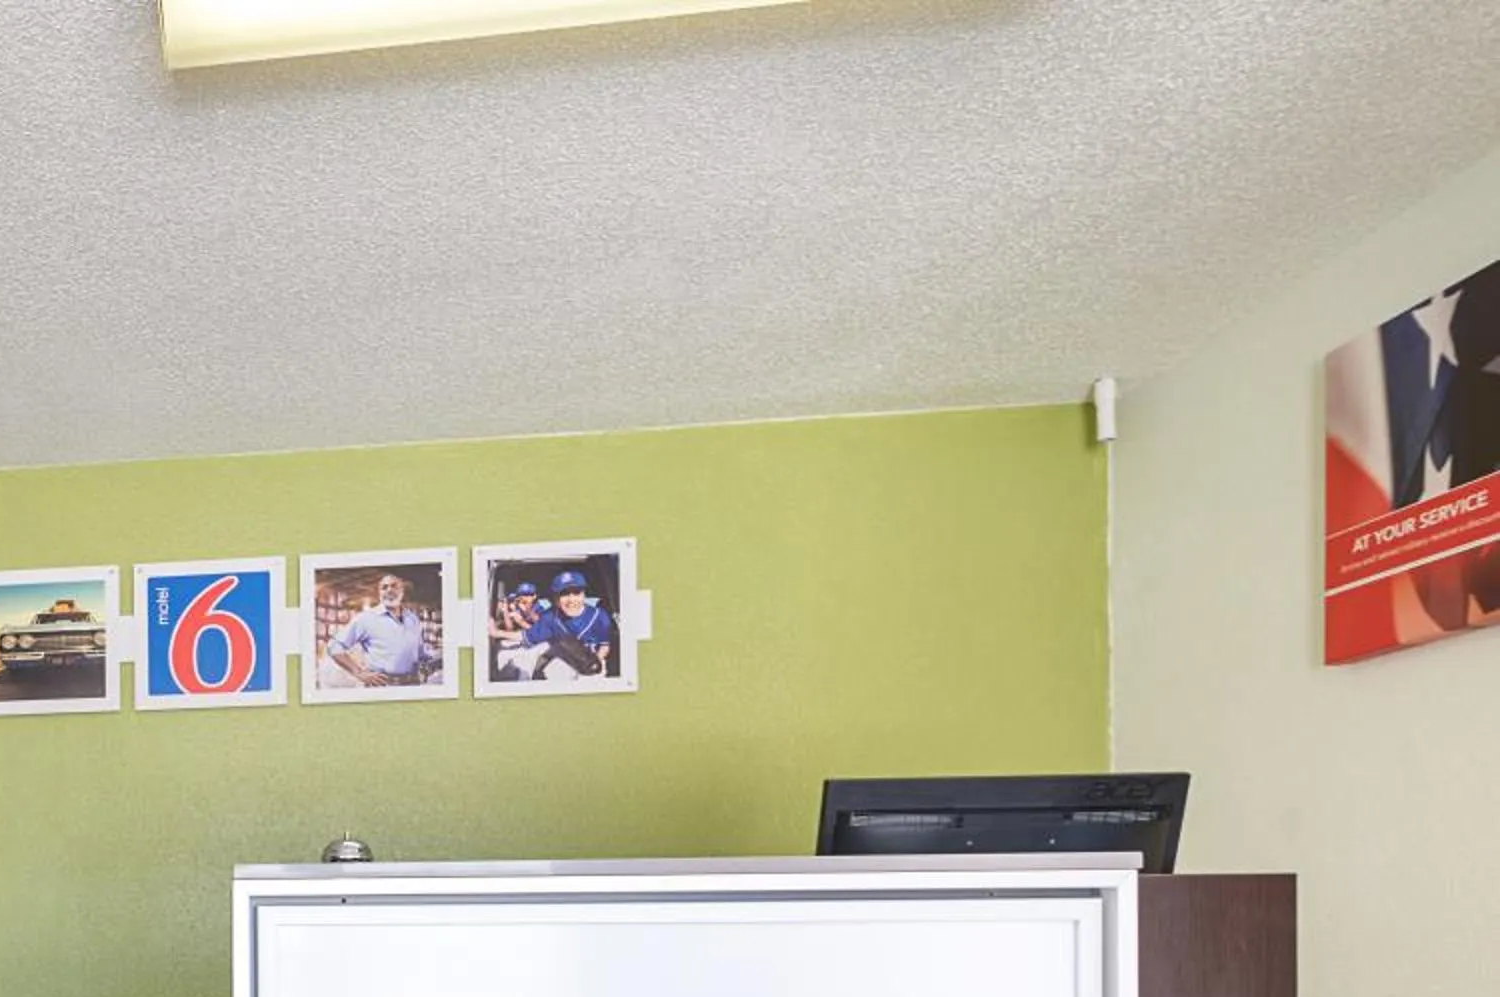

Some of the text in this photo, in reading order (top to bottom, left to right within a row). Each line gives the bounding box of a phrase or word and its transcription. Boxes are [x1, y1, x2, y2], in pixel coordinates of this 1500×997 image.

[1351, 534, 1371, 554] AT
[1373, 517, 1416, 545] YOUR
[1419, 489, 1490, 529] SERVICE
[155, 587, 170, 625] motel
[168, 575, 256, 695] 6
